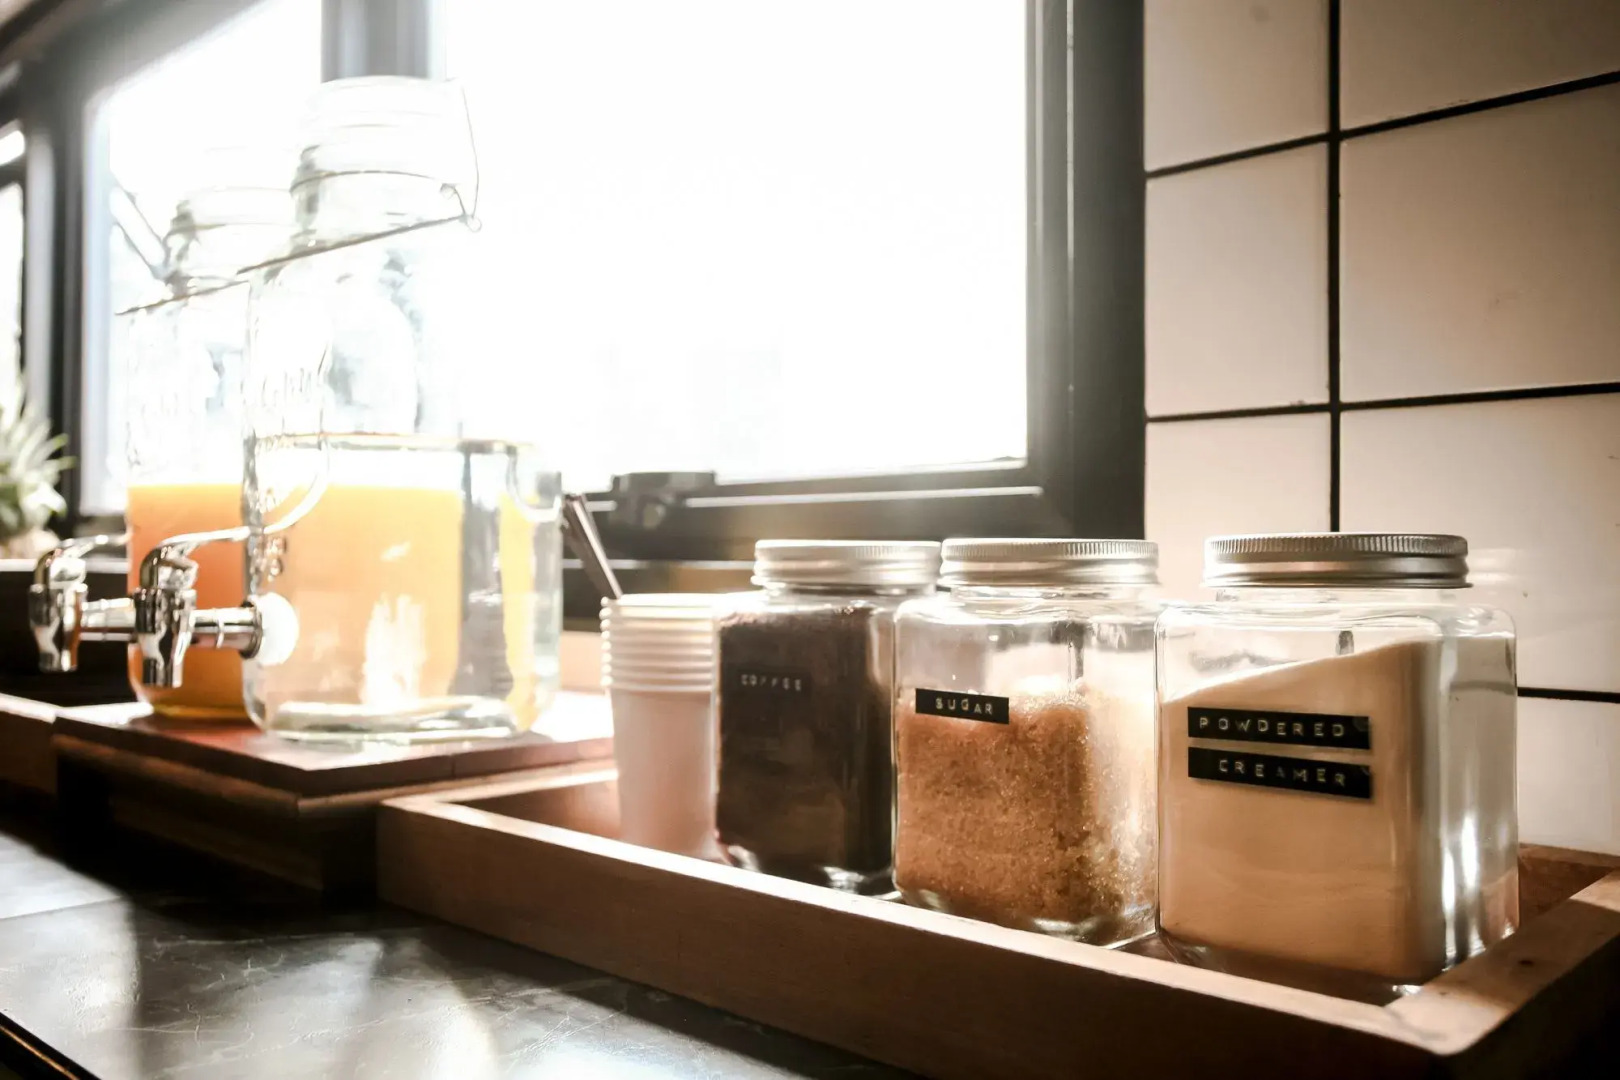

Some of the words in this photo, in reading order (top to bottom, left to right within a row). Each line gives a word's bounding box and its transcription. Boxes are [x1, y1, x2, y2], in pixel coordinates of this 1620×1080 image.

[935, 697, 993, 715] SUGAR
[1199, 716, 1345, 738] POWDERED
[1218, 759, 1346, 786] CREAMER
